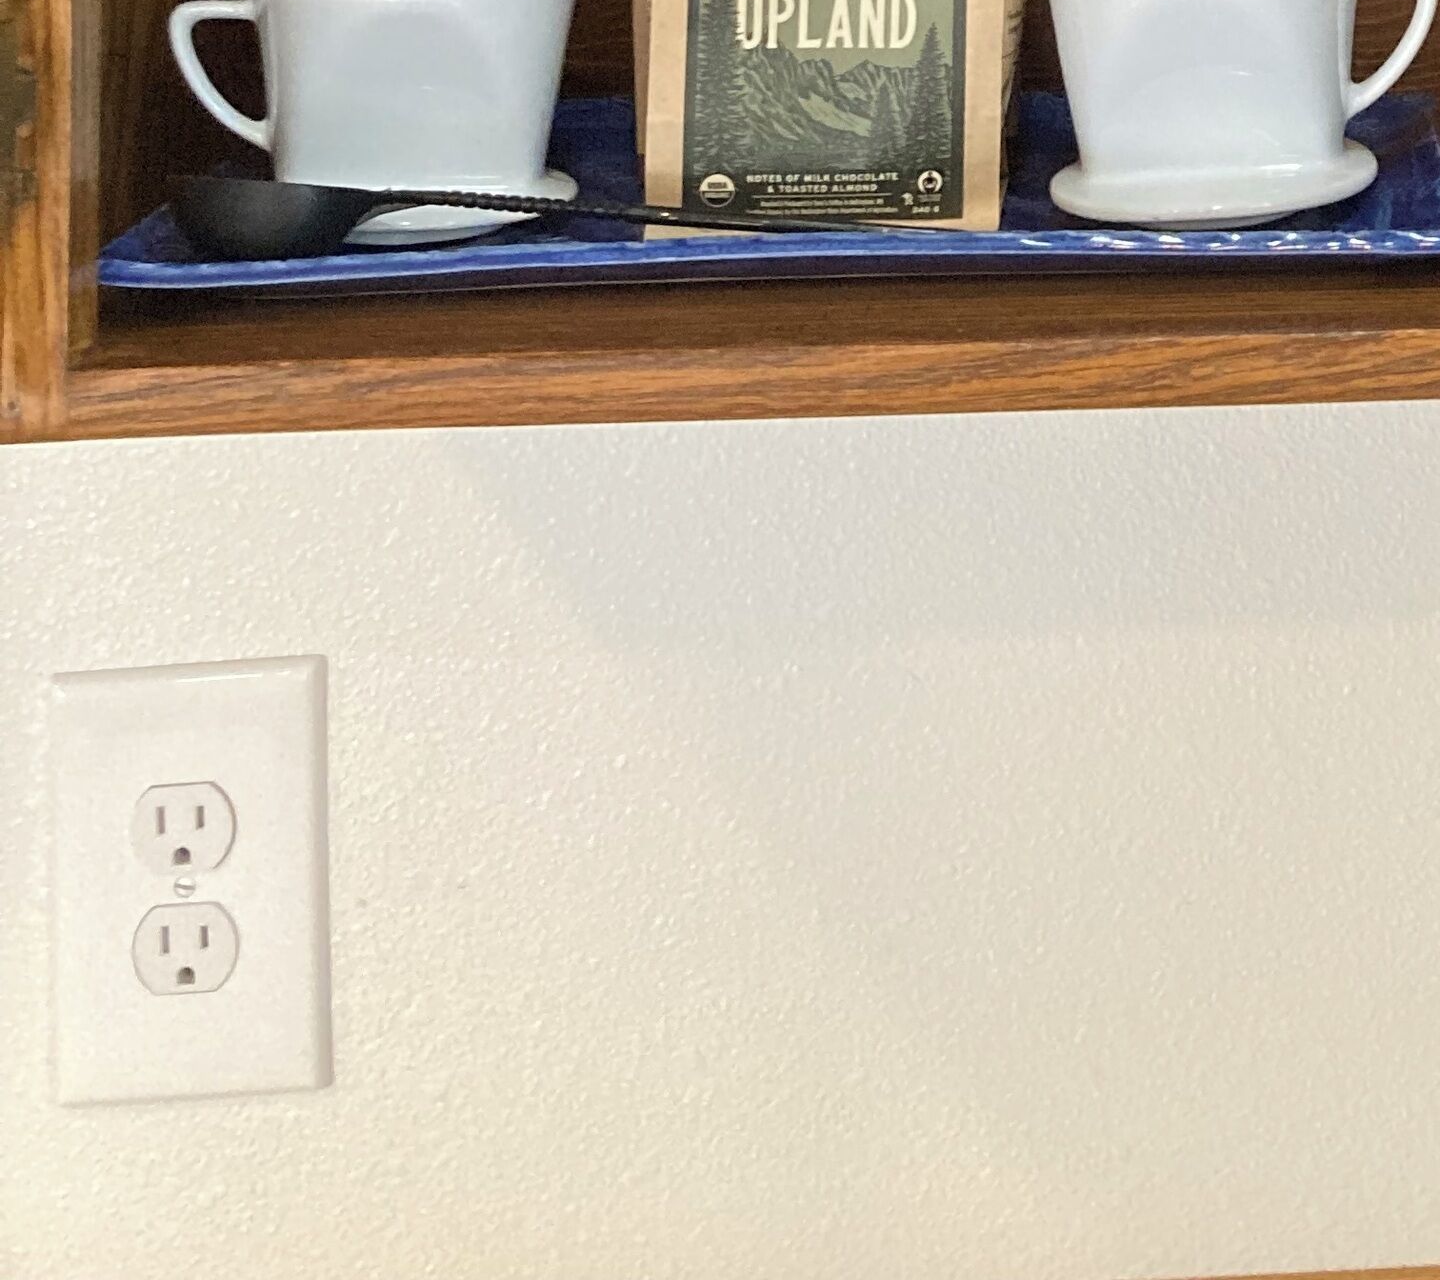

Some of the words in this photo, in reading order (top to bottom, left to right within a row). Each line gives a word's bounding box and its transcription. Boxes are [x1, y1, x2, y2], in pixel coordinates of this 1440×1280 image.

[834, 171, 899, 182] CHOCOLATE
[779, 184, 829, 193] TOASTED
[832, 183, 879, 192] ALMOND
